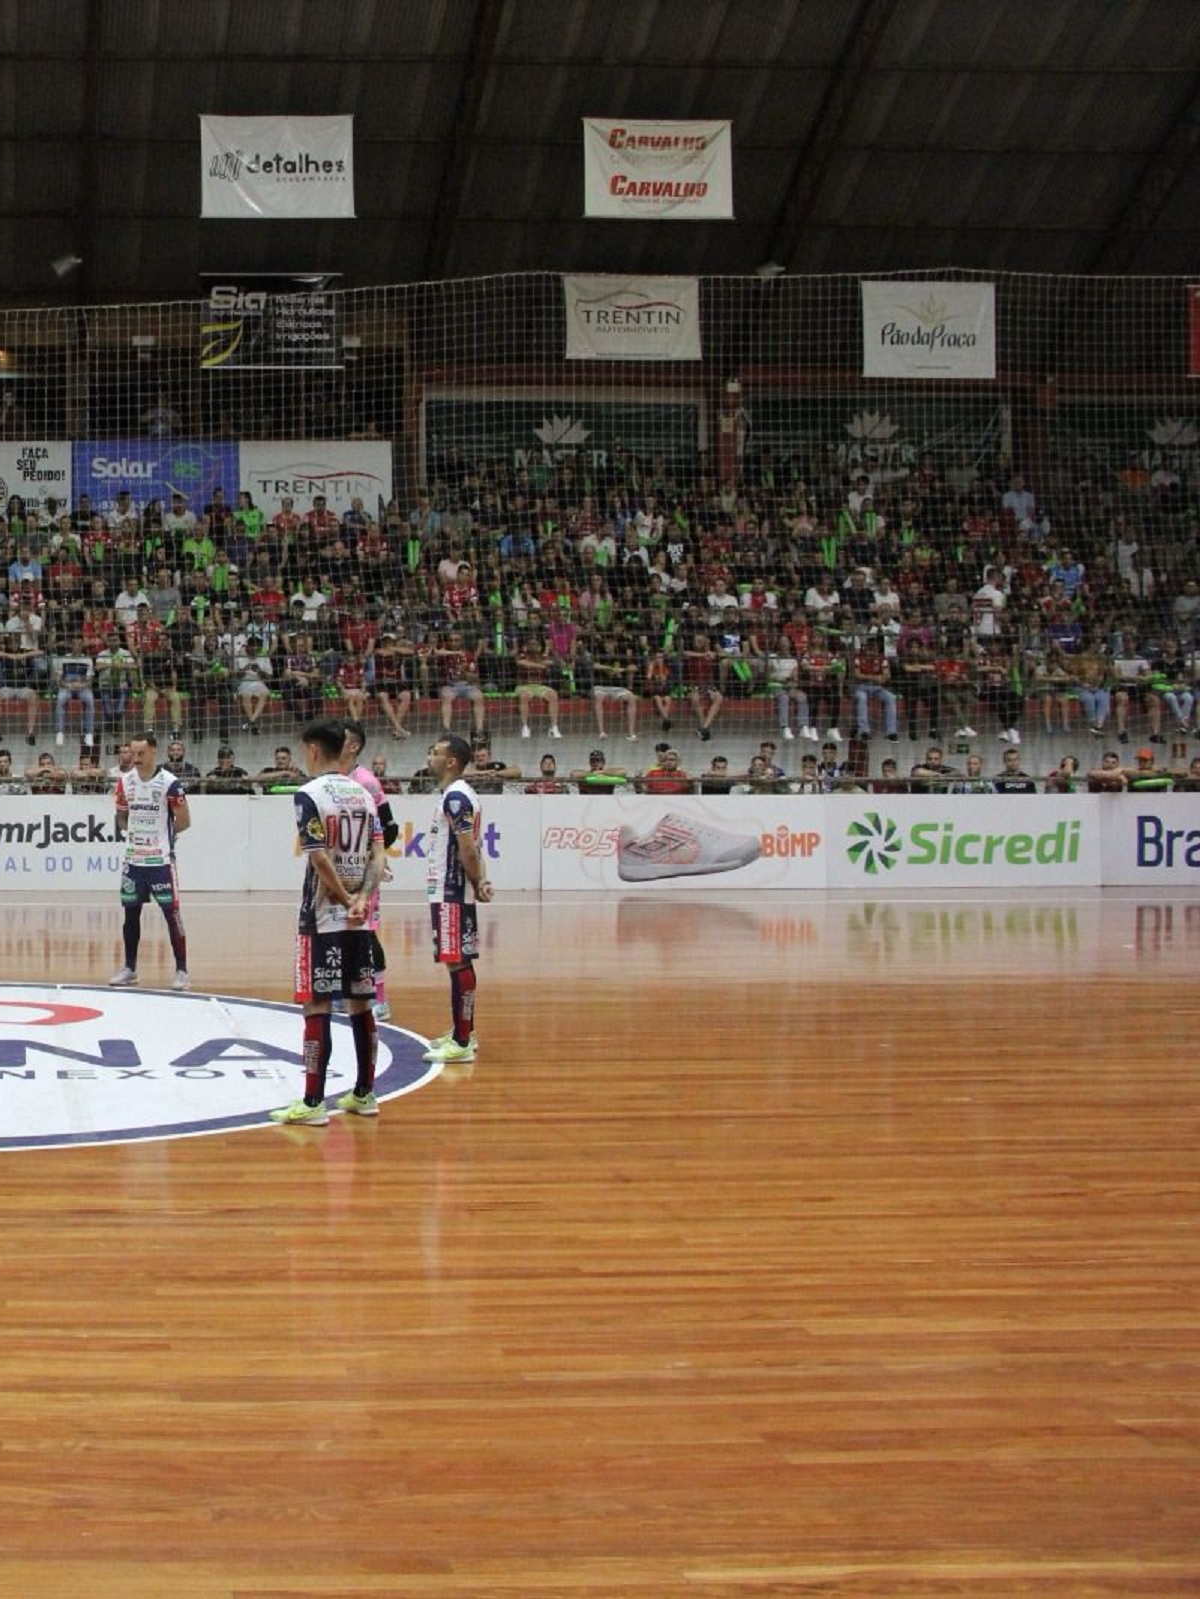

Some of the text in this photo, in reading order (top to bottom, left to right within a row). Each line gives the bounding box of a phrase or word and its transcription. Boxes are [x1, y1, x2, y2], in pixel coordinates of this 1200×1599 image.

[245, 152, 346, 174] detalhes
[581, 310, 681, 325] TRENTIN
[21, 446, 49, 460] FAÇA
[16, 459, 37, 471] SEU
[91, 457, 159, 479] Solar
[23, 469, 66, 481] PEDIDO!
[257, 480, 372, 495] TRENTIN
[339, 809, 367, 853] 07
[907, 820, 1082, 866] Sicredi
[46, 856, 73, 872] DO
